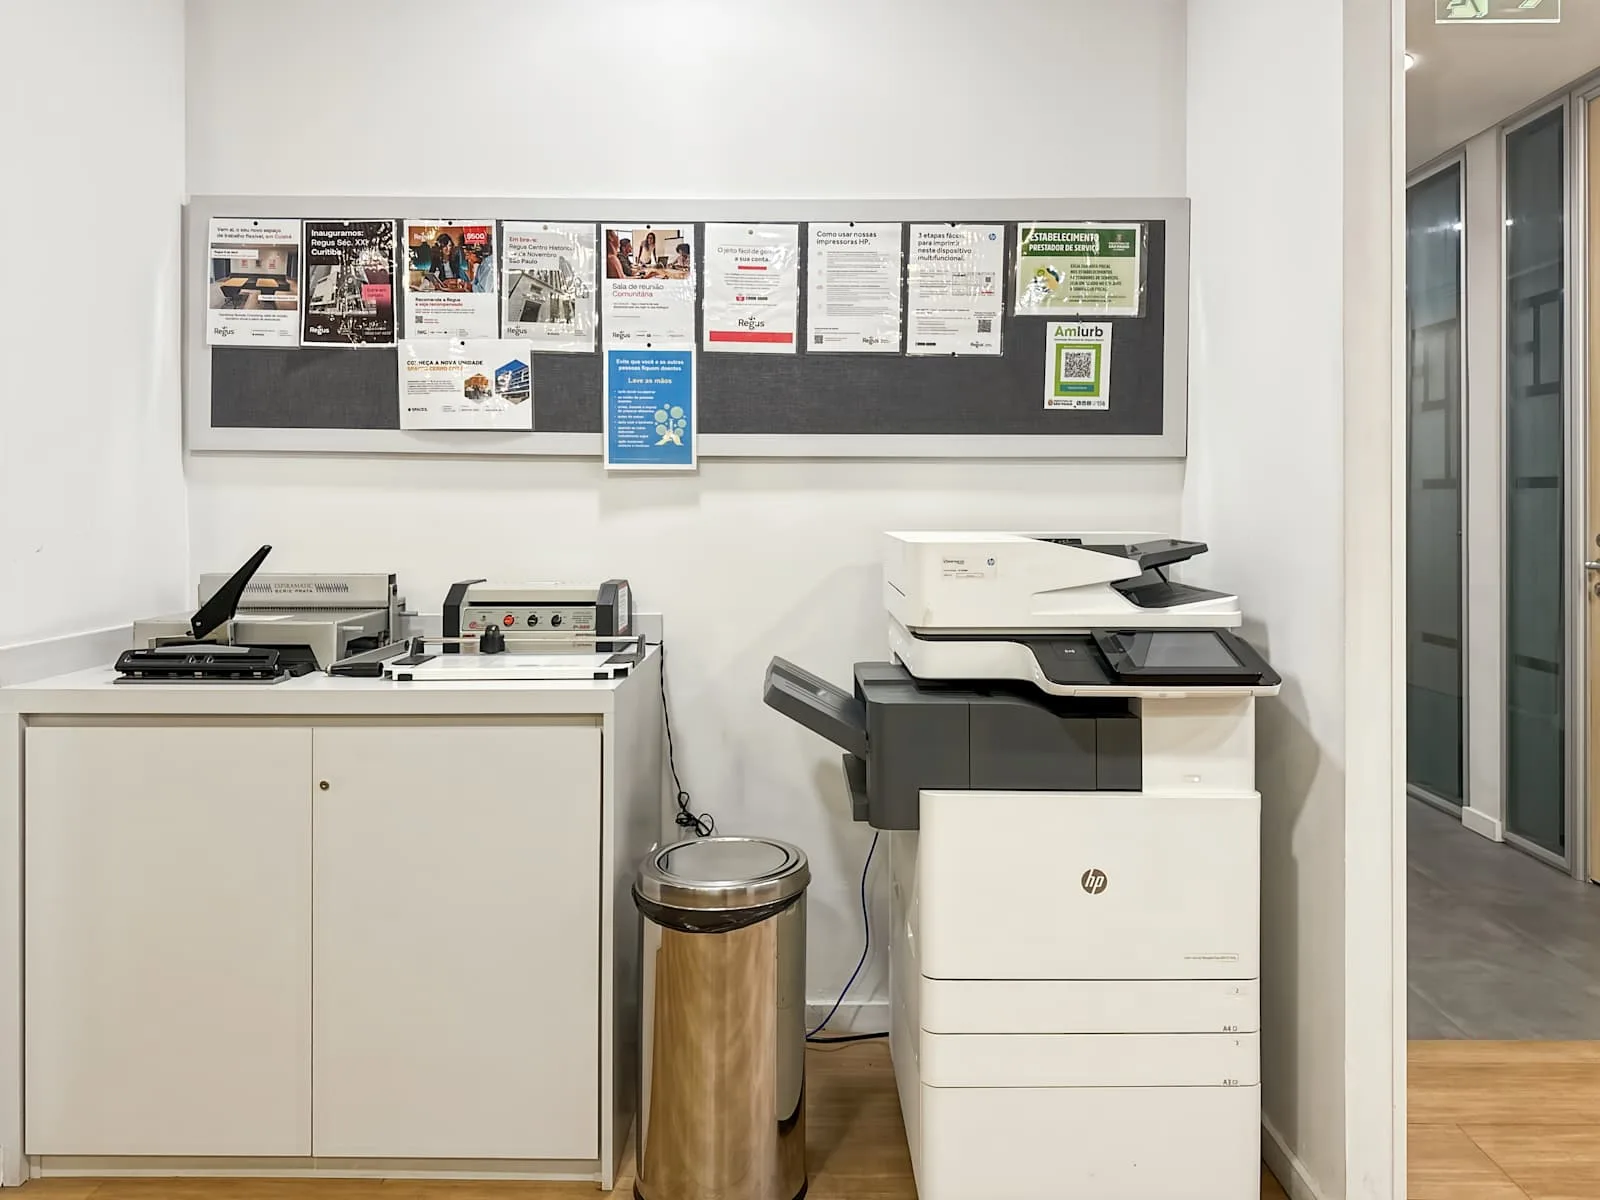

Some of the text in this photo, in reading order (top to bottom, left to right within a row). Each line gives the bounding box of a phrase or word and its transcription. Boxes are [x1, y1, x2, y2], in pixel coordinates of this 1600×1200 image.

[311, 230, 364, 238] Inauguramos:
[1030, 233, 1099, 242] ESTABELECIMENTO
[311, 239, 335, 247] Regus
[738, 316, 765, 330] Regus
[214, 327, 234, 337] Regus
[310, 325, 330, 335] Regus
[1055, 326, 1103, 336] Amlurb
[862, 337, 879, 345] Regus
[1084, 868, 1105, 895] hp
